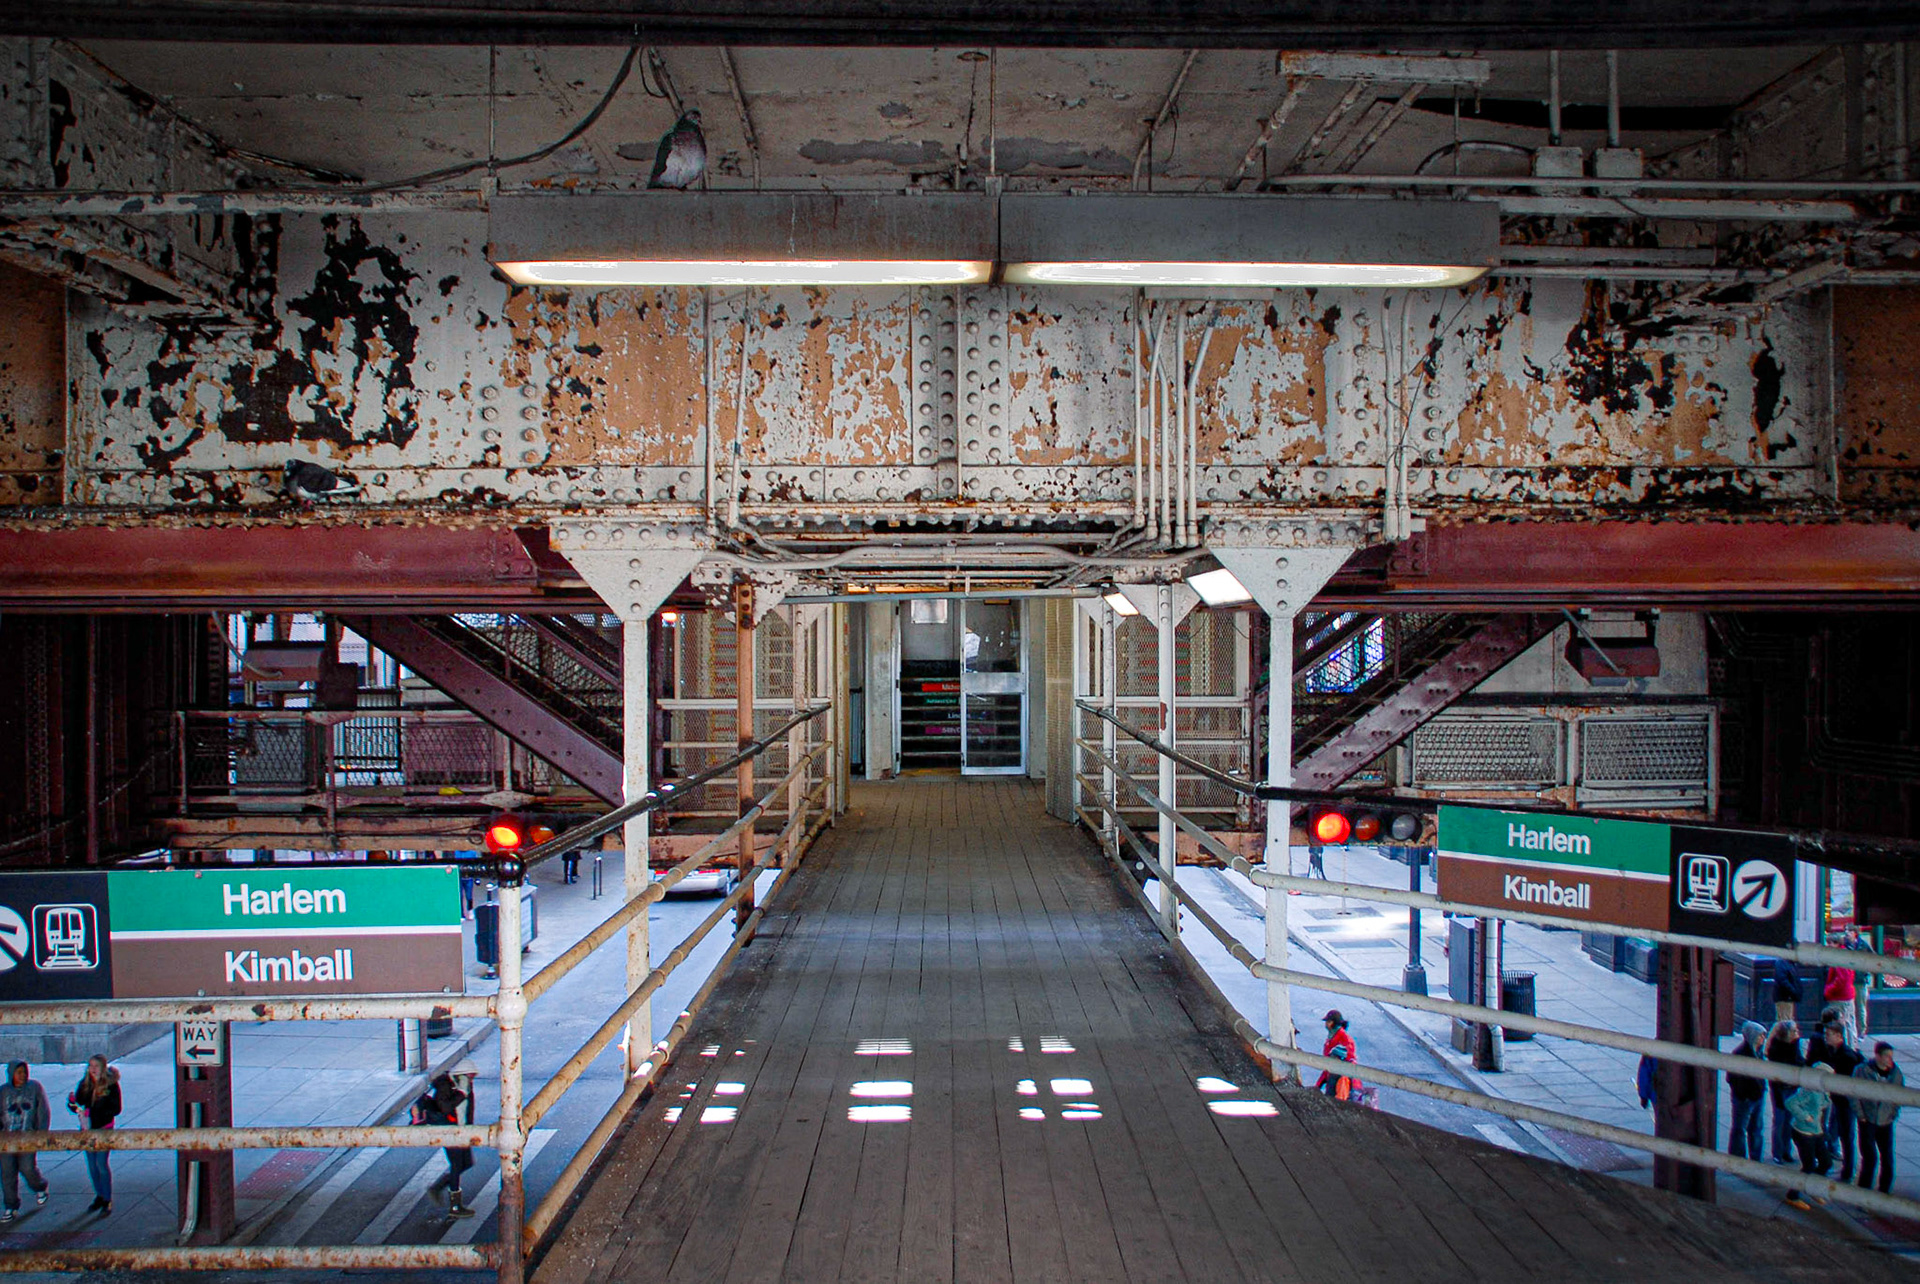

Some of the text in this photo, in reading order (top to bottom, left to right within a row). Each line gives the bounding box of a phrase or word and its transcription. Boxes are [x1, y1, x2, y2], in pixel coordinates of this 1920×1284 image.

[1508, 822, 1591, 855] Harlem
[223, 883, 346, 915] Harlem
[1504, 874, 1590, 909] Kimball
[225, 949, 353, 982] Kimball
[183, 1027, 217, 1041] WAY
